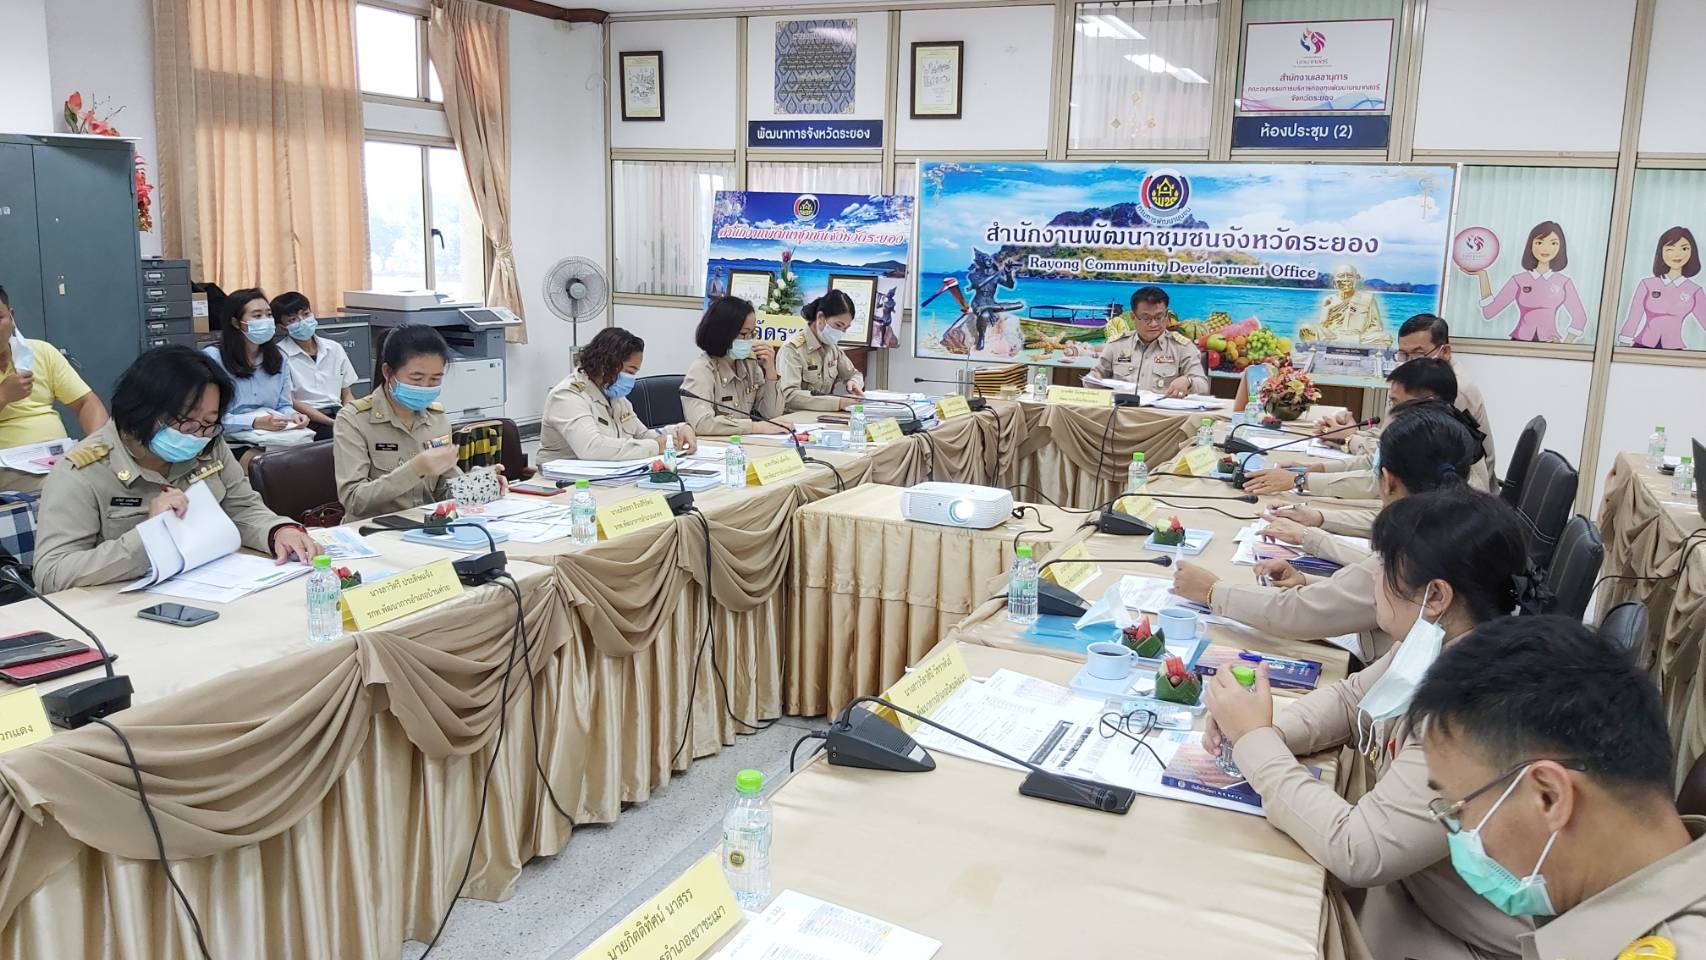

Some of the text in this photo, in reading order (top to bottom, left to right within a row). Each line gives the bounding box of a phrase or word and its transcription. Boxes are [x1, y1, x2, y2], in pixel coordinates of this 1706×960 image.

[756, 126, 871, 142] พัฒนาการจังหวัดระยอง
[1260, 123, 1353, 141] ห้องประชุม (2)
[987, 221, 1379, 252] สำนักงานพัฒนาชุมชนจังหวัดระยอง
[1030, 257, 1317, 279] Rayong Community Development Office
